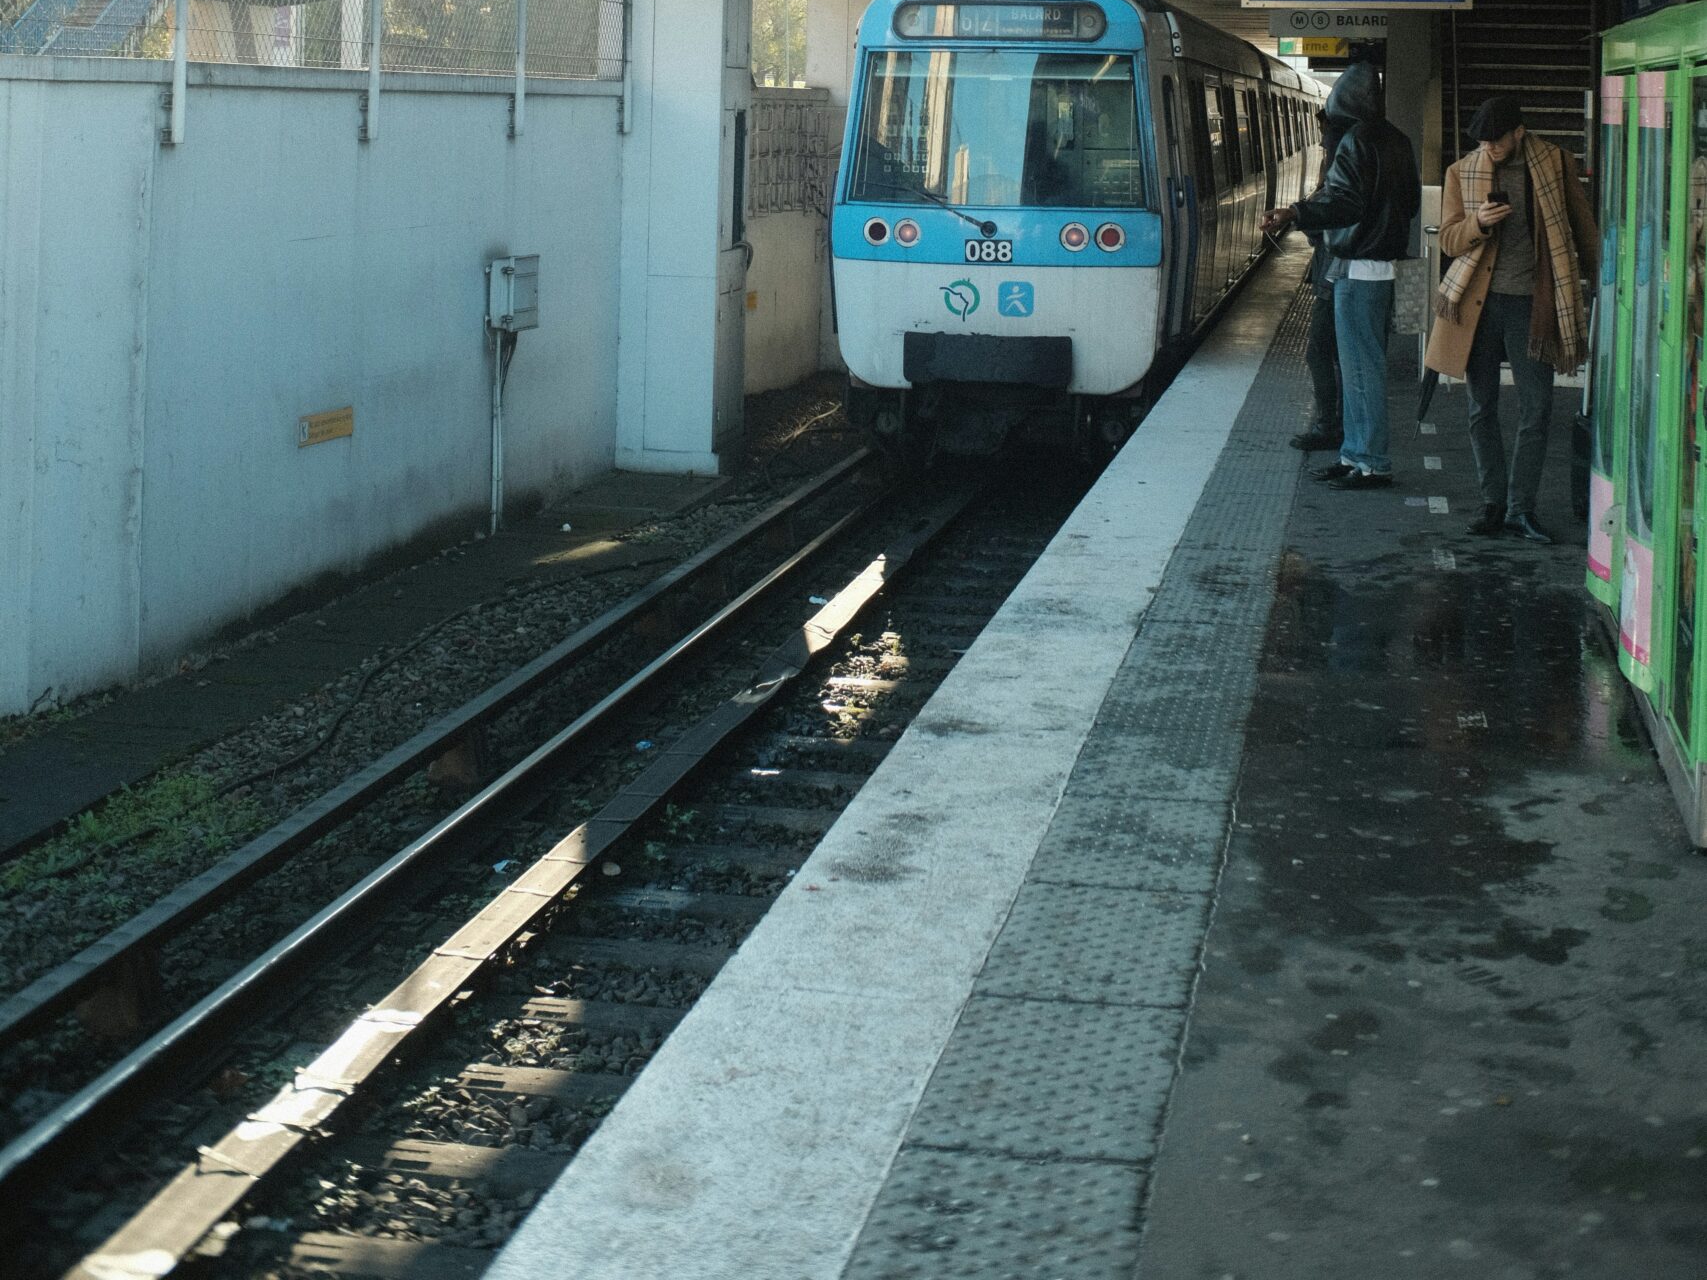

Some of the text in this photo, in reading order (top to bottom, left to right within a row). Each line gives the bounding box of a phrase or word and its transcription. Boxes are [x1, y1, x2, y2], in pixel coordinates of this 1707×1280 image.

[1011, 8, 1061, 21] BALARD
[1336, 15, 1388, 26] BALARD
[965, 240, 1012, 261] 088
